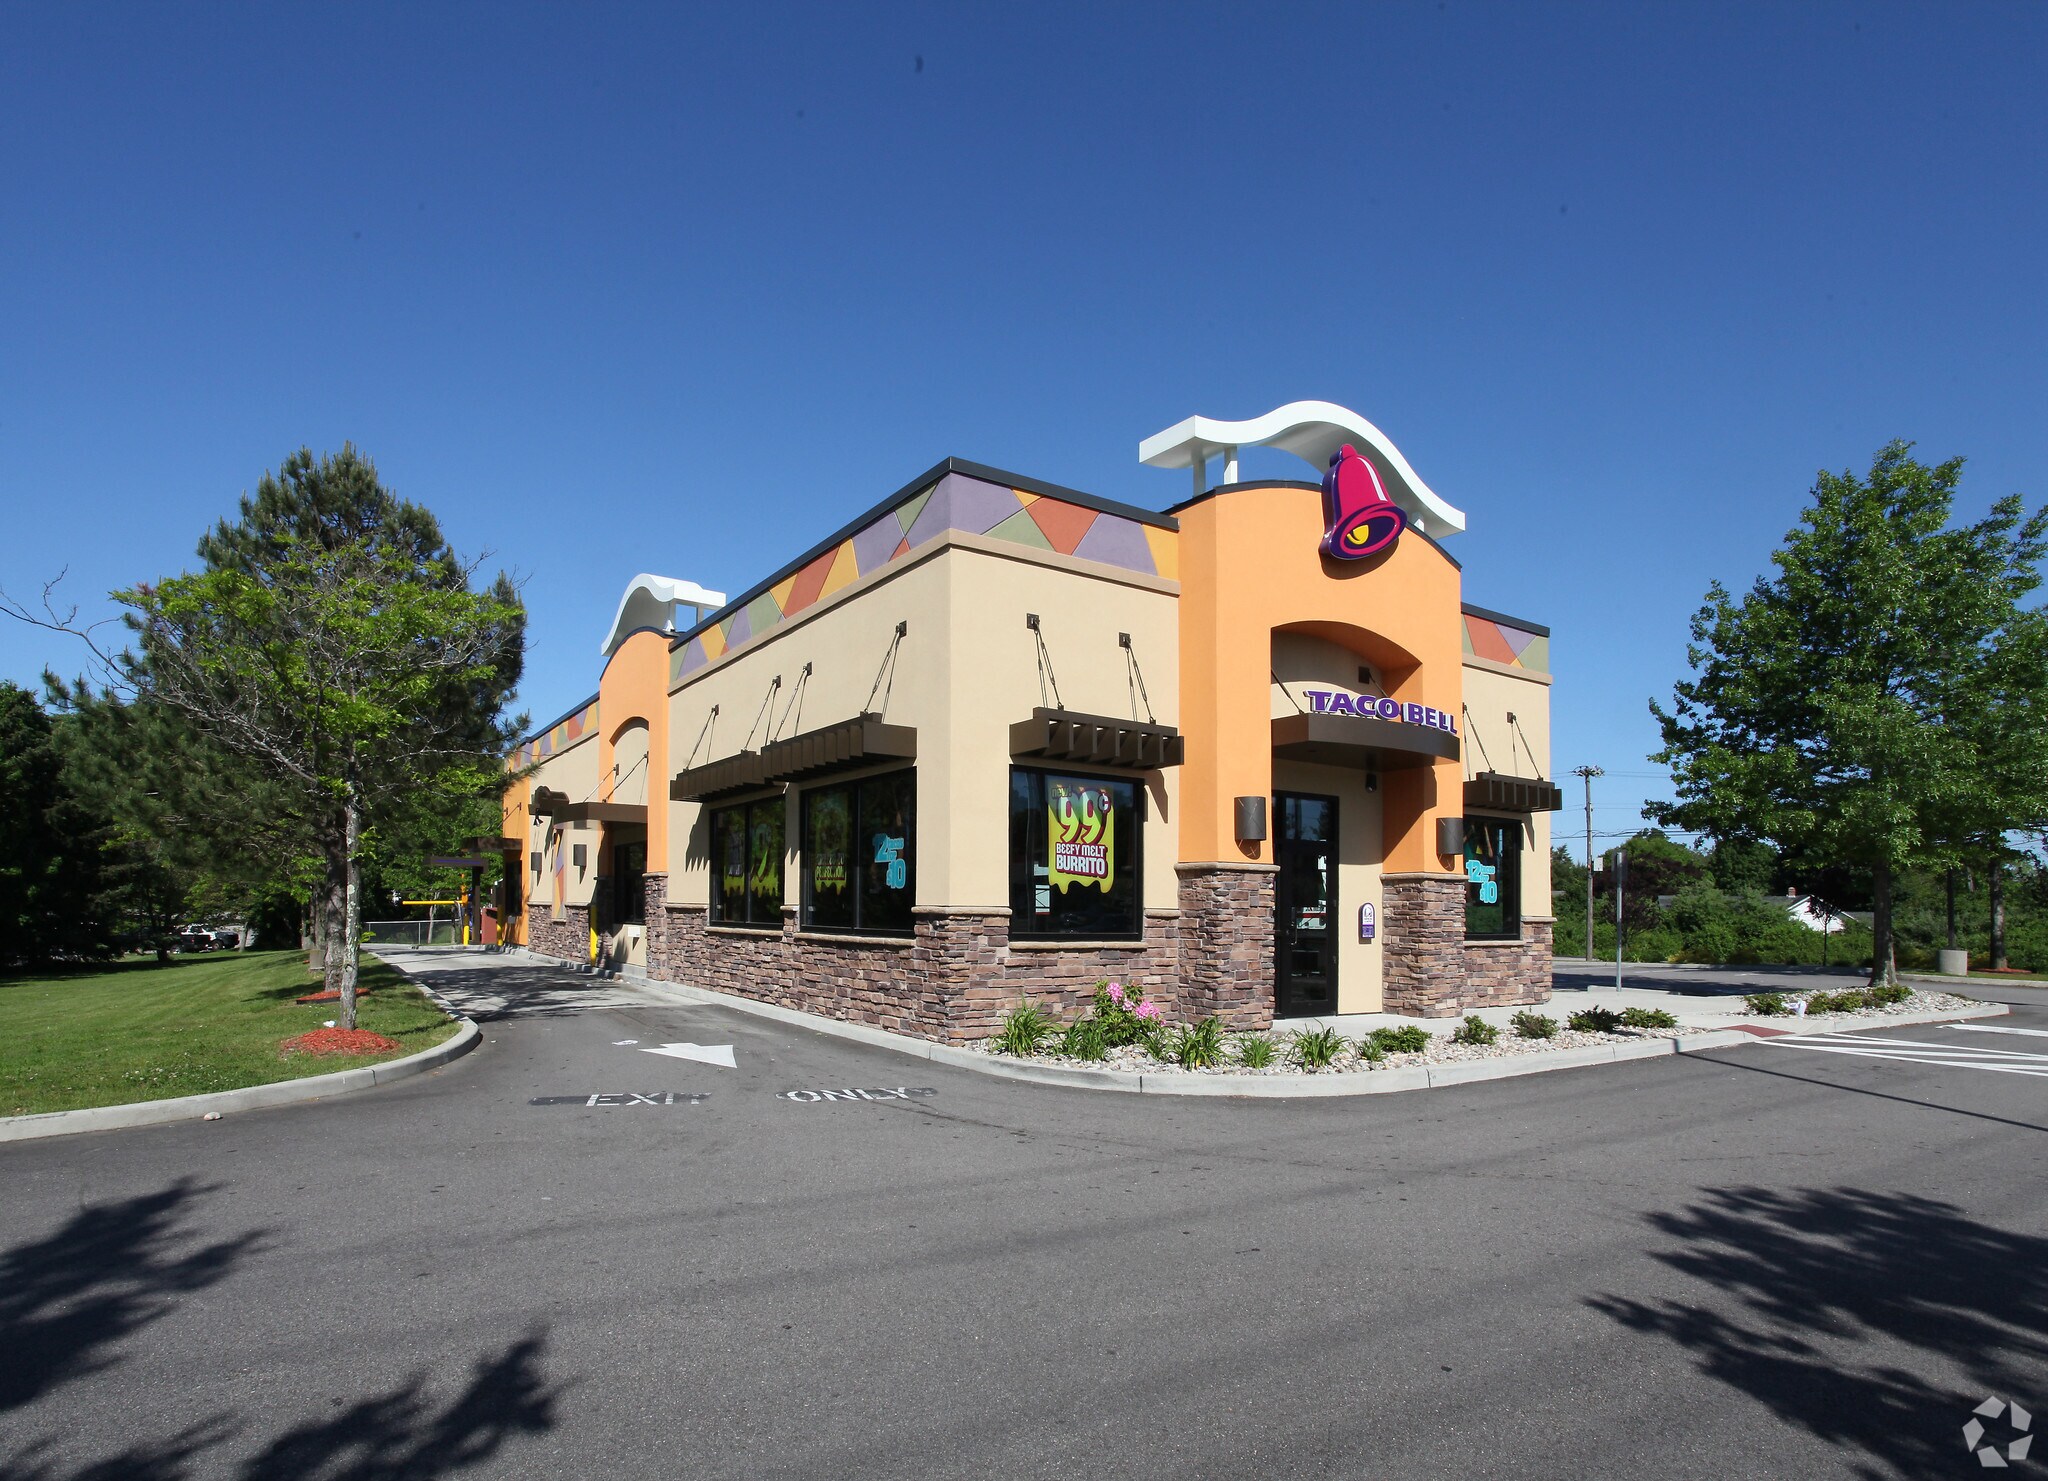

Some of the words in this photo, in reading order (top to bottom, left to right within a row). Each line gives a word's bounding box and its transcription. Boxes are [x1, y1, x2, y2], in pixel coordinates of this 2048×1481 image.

[1303, 690, 1400, 719] TACO
[1402, 702, 1458, 735] BELL
[1056, 842, 1080, 856] BEEFY
[1081, 844, 1105, 858] MELT
[1056, 854, 1106, 876] BURRITO
[787, 1087, 909, 1102] ONLY
